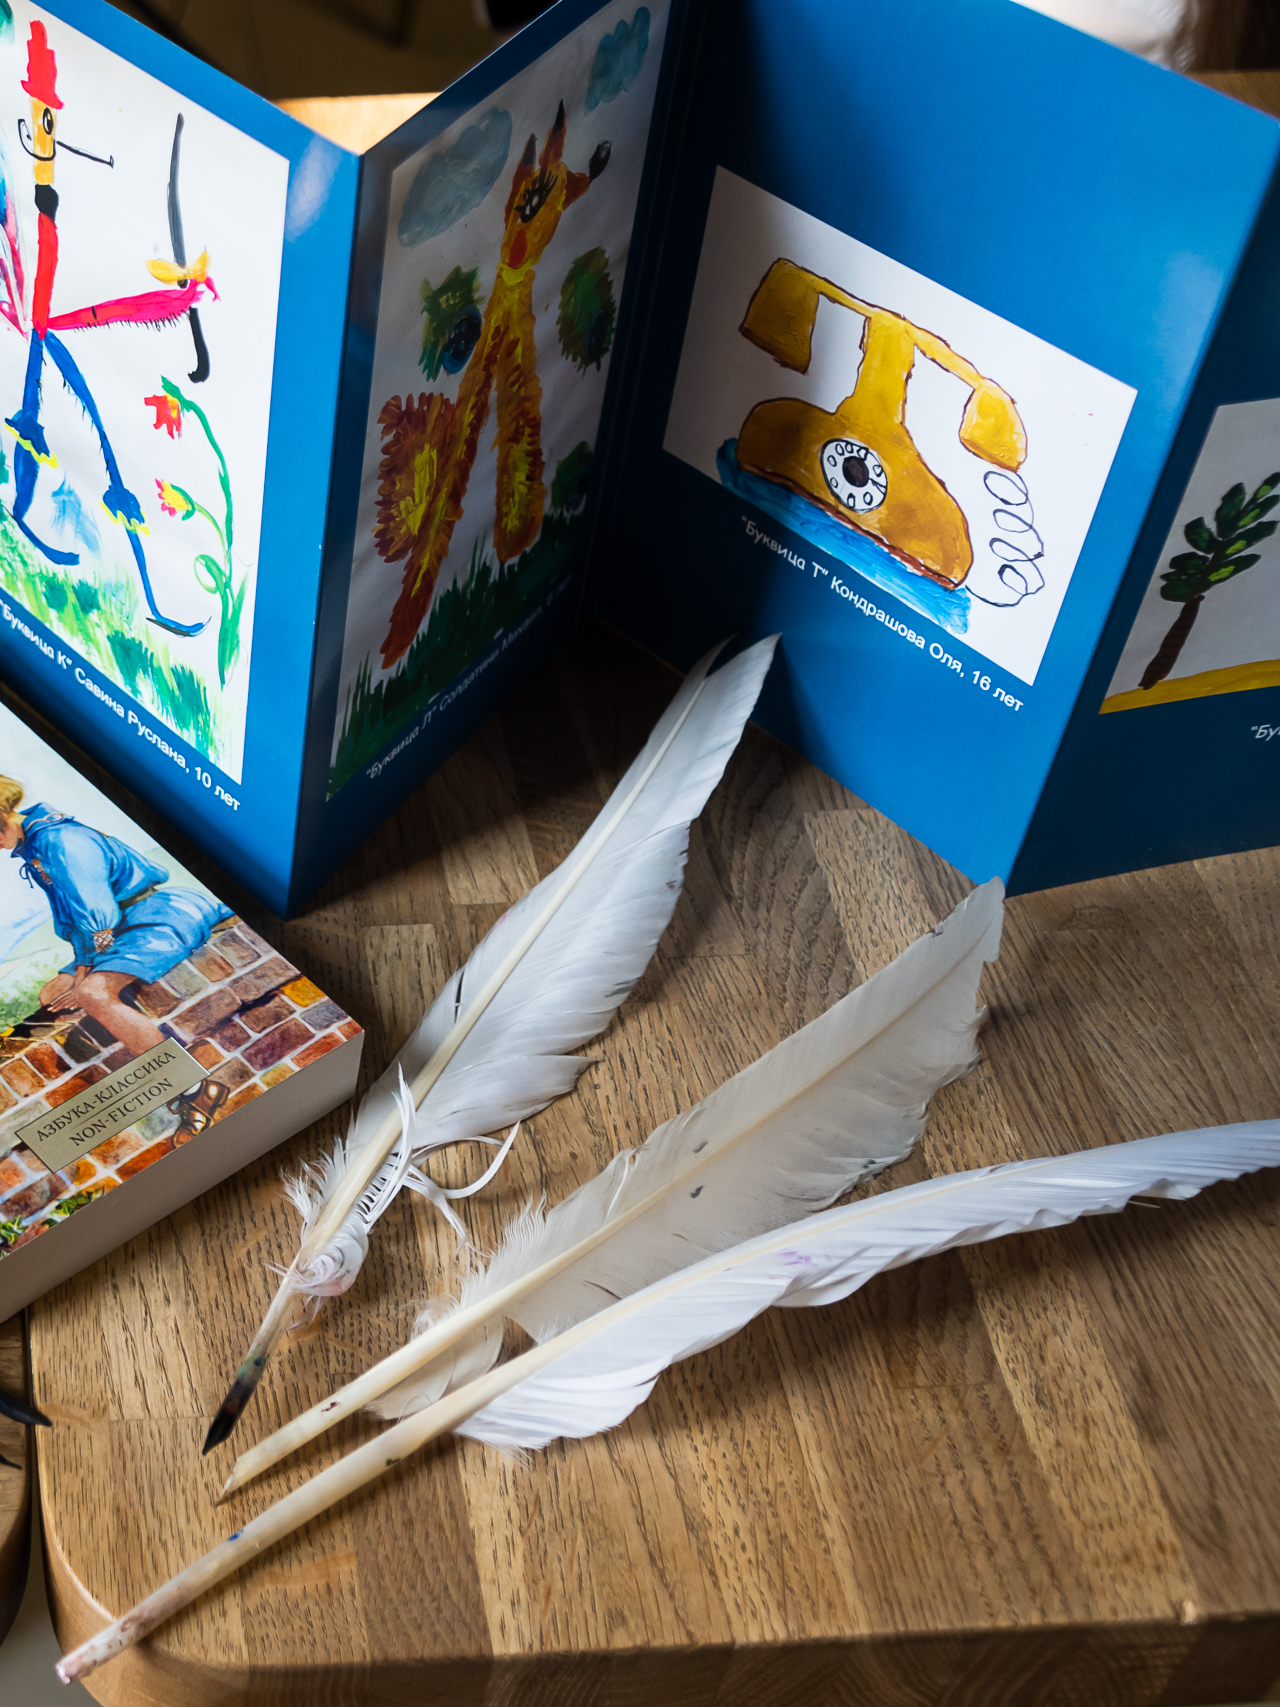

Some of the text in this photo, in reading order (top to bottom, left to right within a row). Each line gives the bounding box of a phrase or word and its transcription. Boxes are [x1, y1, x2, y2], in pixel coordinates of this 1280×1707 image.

[830, 575, 925, 649] Кондрашова
[928, 642, 965, 678] Оля,
[972, 669, 992, 691] 16
[993, 685, 1024, 712] лет
[74, 667, 125, 718] Савина
[127, 710, 190, 773] Руслана,
[194, 767, 212, 788] 10
[214, 785, 241, 811] лет
[36, 1051, 177, 1142] АЗБУКА-КЛАССИКА
[69, 1078, 173, 1147] NON-FICTION
